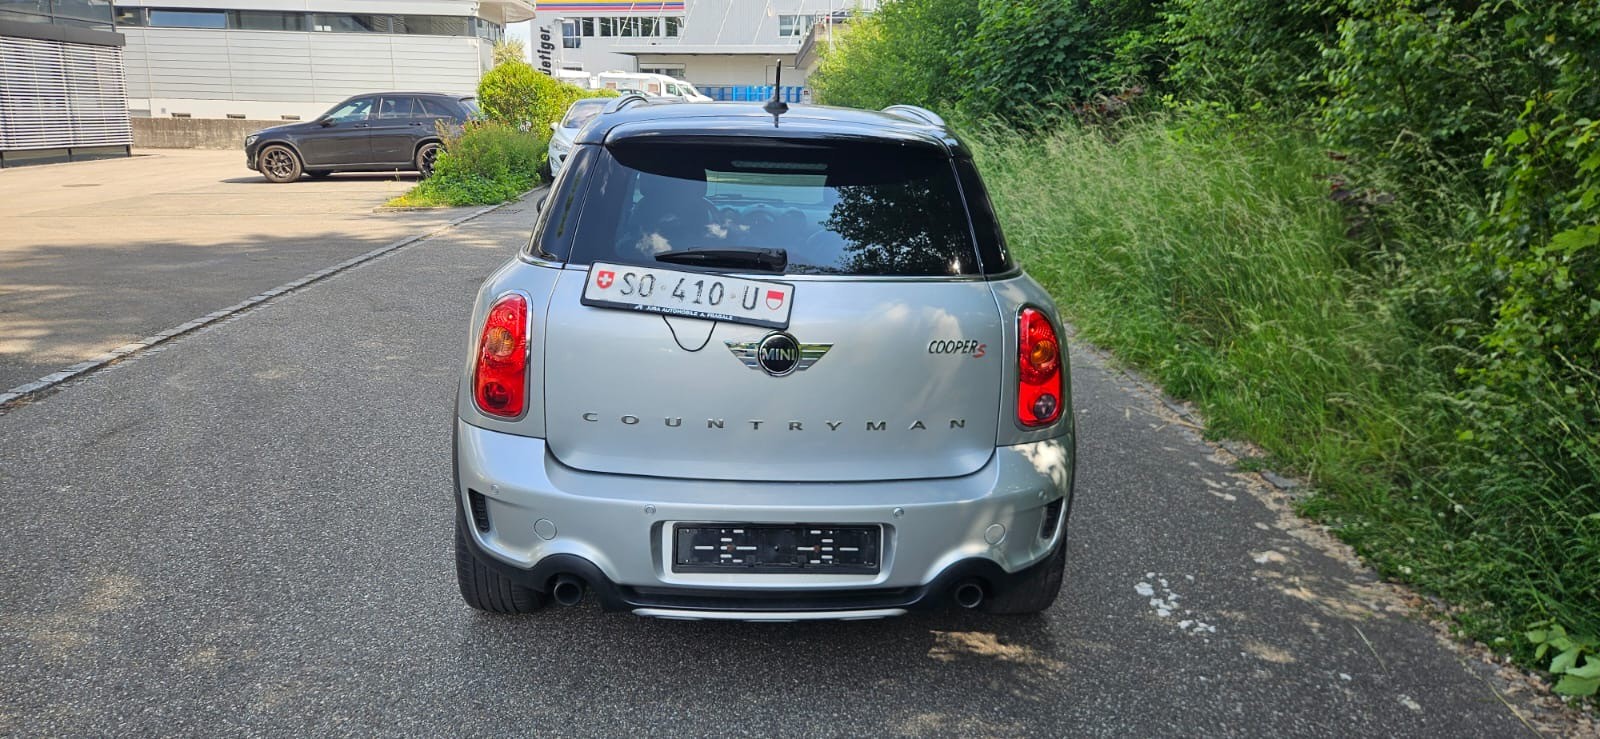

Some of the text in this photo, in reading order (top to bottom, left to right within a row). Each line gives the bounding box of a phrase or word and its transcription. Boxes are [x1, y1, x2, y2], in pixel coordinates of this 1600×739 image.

[620, 272, 759, 310] SO 410 U
[761, 347, 796, 361] MINI
[928, 339, 979, 354] COOPER
[582, 411, 966, 431] COUNTRYMAN
